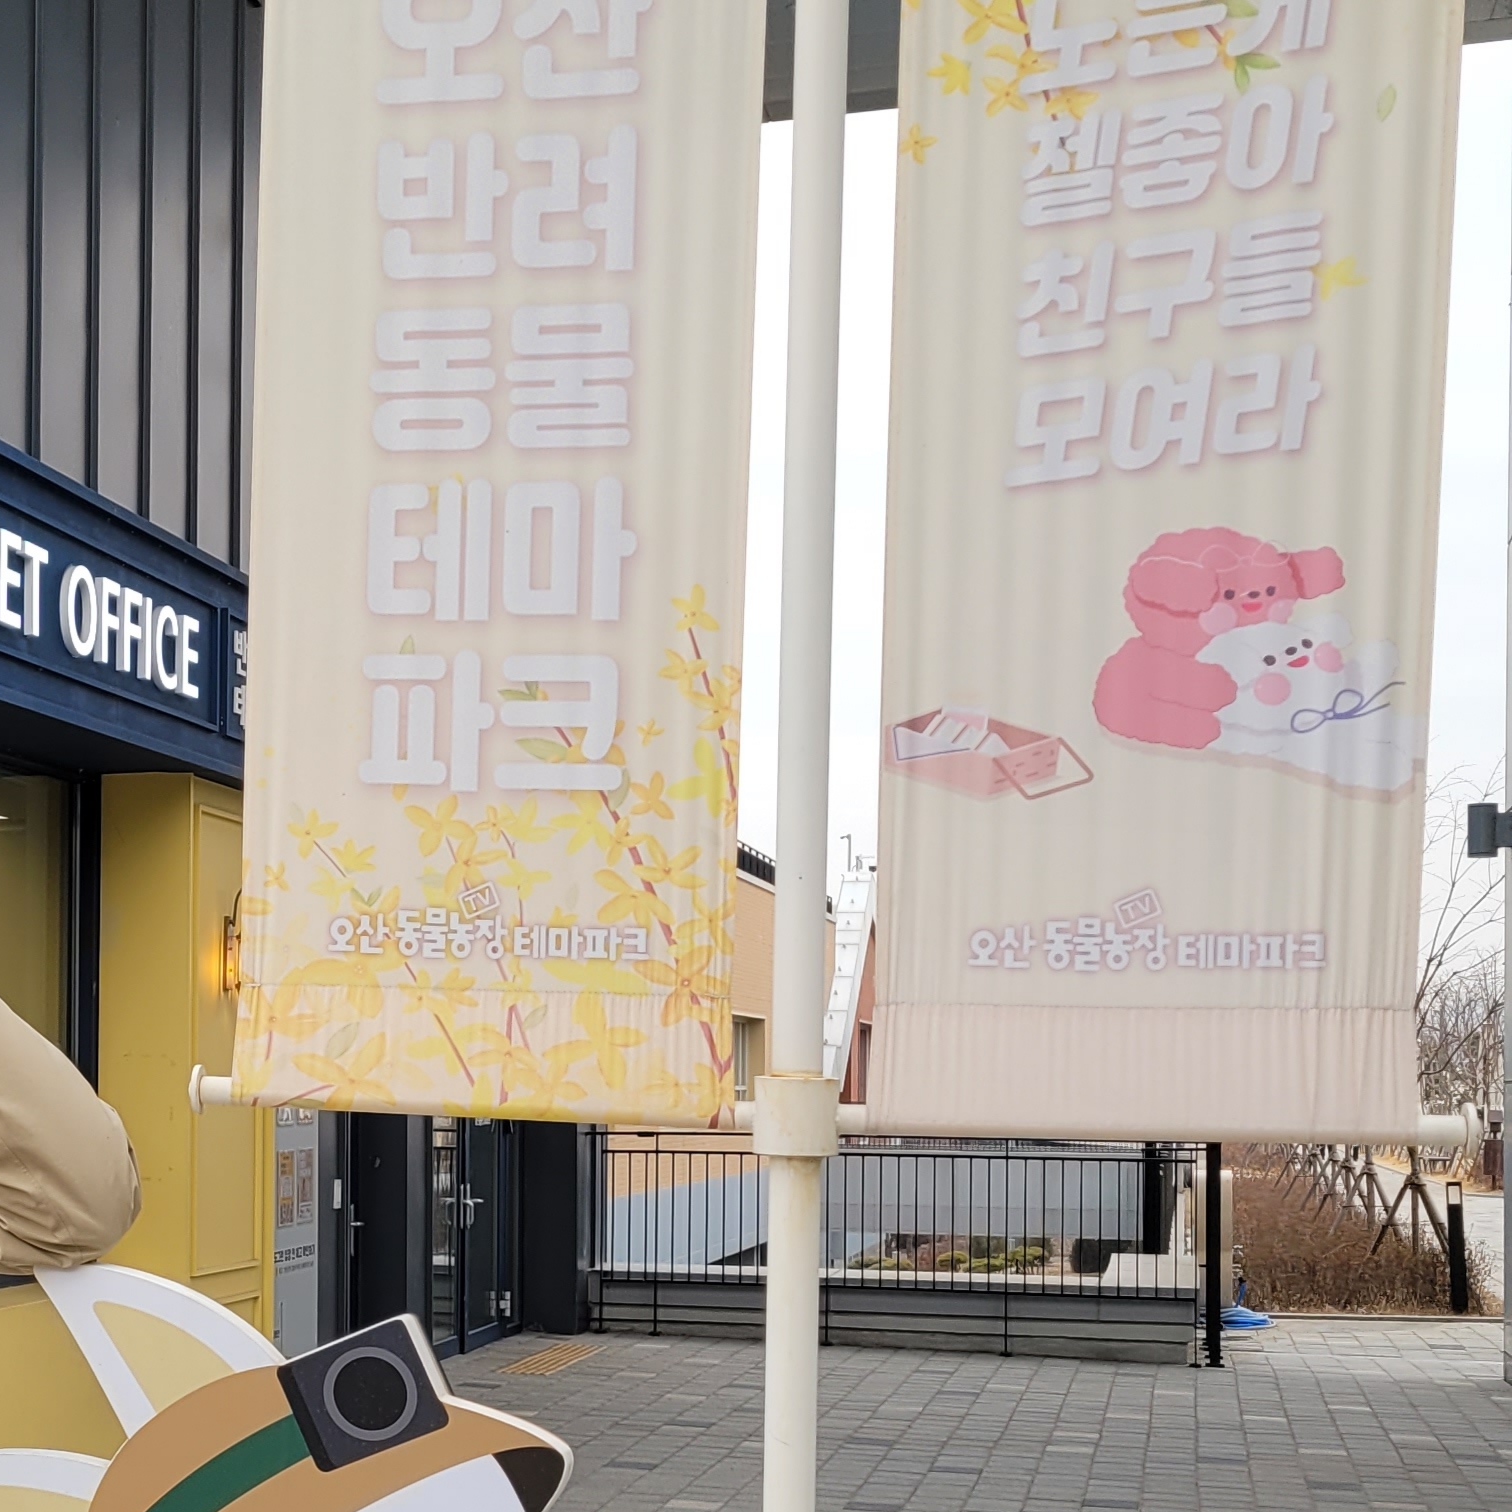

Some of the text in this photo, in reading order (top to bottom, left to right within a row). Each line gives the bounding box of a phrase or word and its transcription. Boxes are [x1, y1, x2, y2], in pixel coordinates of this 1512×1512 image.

[376, 124, 638, 280] 반려
[1015, 209, 1324, 359] 친구들
[369, 303, 634, 452] 동물
[1005, 343, 1323, 489] 모여라
[365, 475, 638, 622] 테마
[59, 563, 200, 699] OFFICE
[358, 649, 625, 793] 파크
[327, 907, 649, 961] 오산 동물농장 테마파크
[463, 887, 491, 910] TV
[967, 917, 1327, 972] 오산 동물농장 테마파크
[1121, 894, 1152, 921] TV
